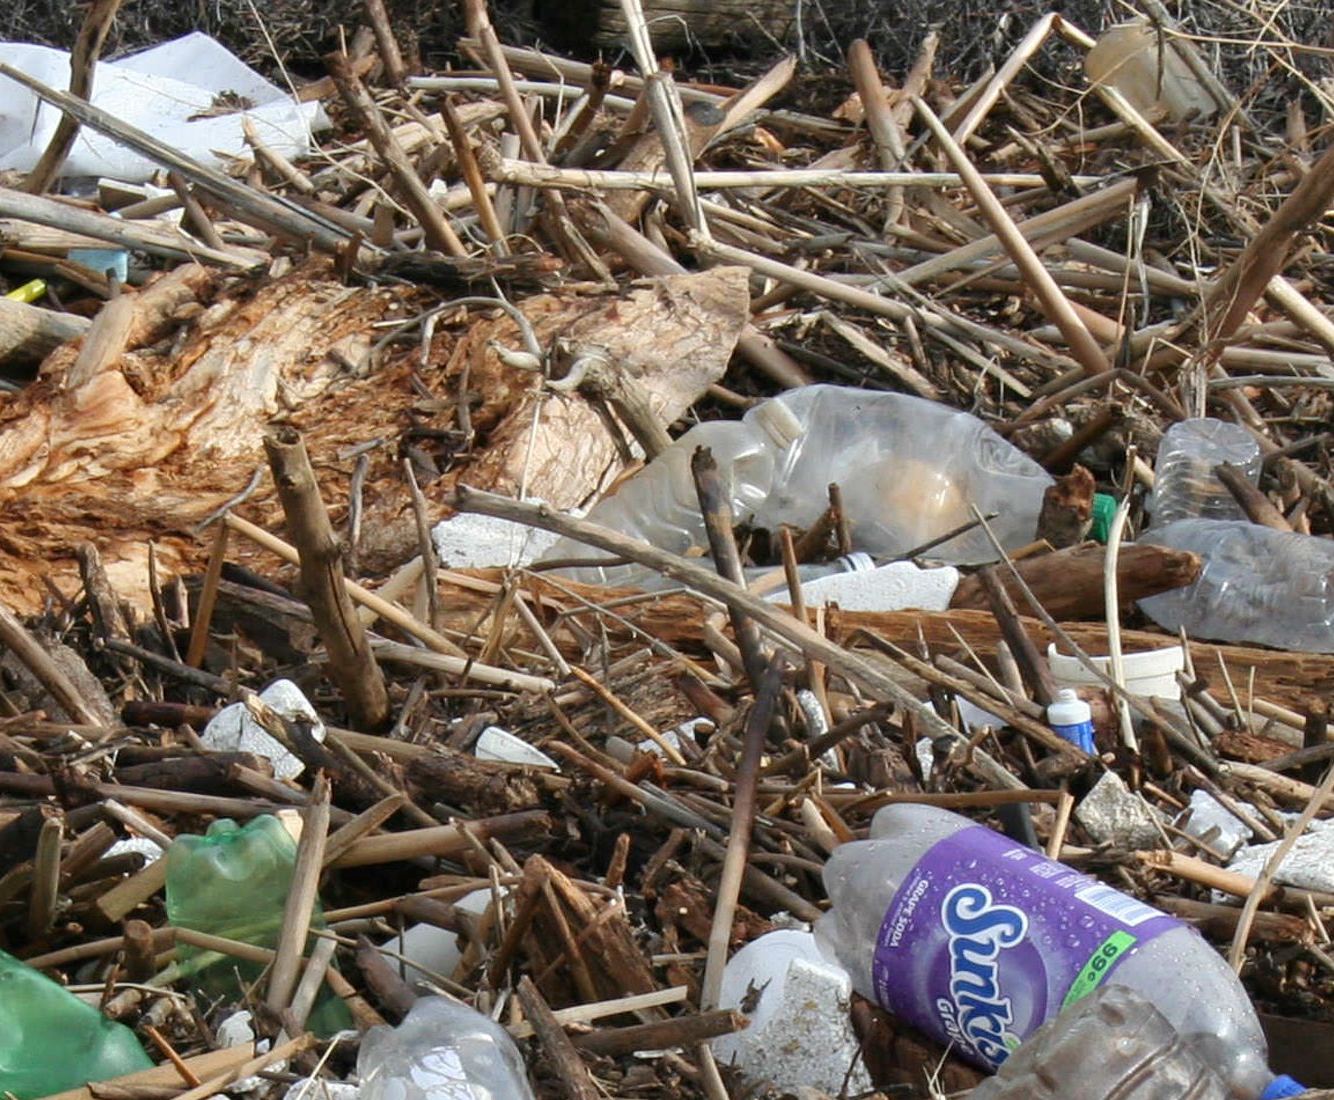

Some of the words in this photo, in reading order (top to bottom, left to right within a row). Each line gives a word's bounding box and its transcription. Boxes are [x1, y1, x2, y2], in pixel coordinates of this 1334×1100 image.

[902, 879, 929, 916] GRAPE
[890, 916, 908, 948] SODA
[941, 883, 1028, 1067] Sunkis
